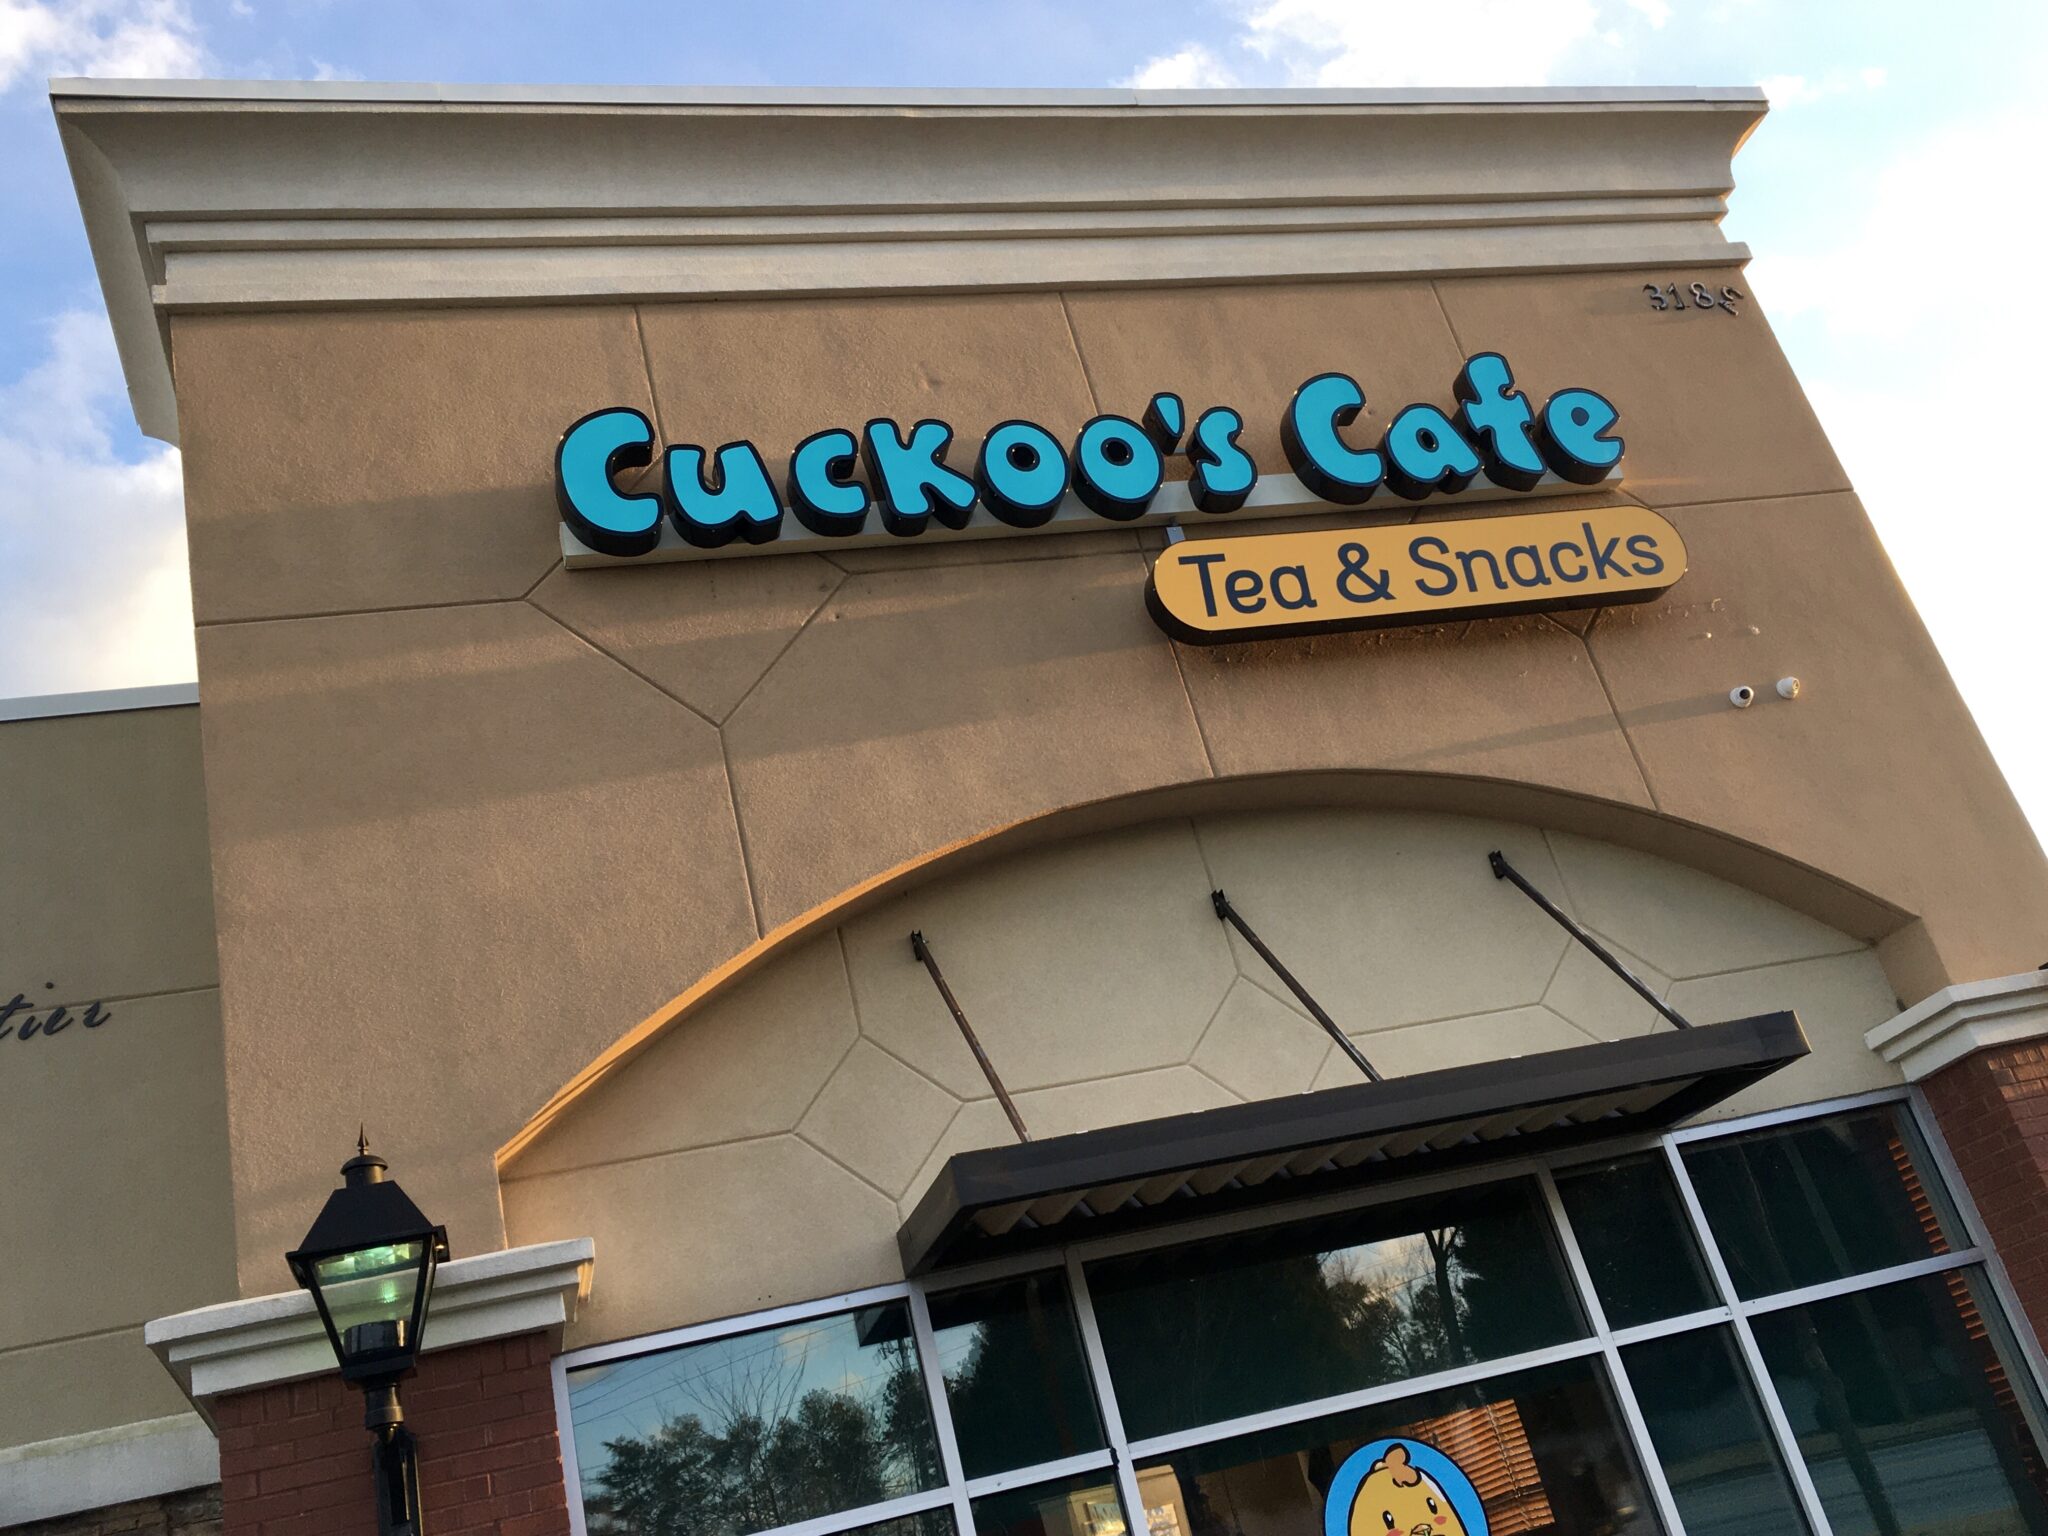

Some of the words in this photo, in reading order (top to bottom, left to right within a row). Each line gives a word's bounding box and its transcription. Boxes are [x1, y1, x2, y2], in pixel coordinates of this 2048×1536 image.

[555, 391, 1258, 557] Cuckoo's
[1279, 351, 1625, 505] Cafe
[1178, 552, 1318, 618] Tea
[1336, 541, 1396, 603] &
[1407, 522, 1666, 597] Snacks
